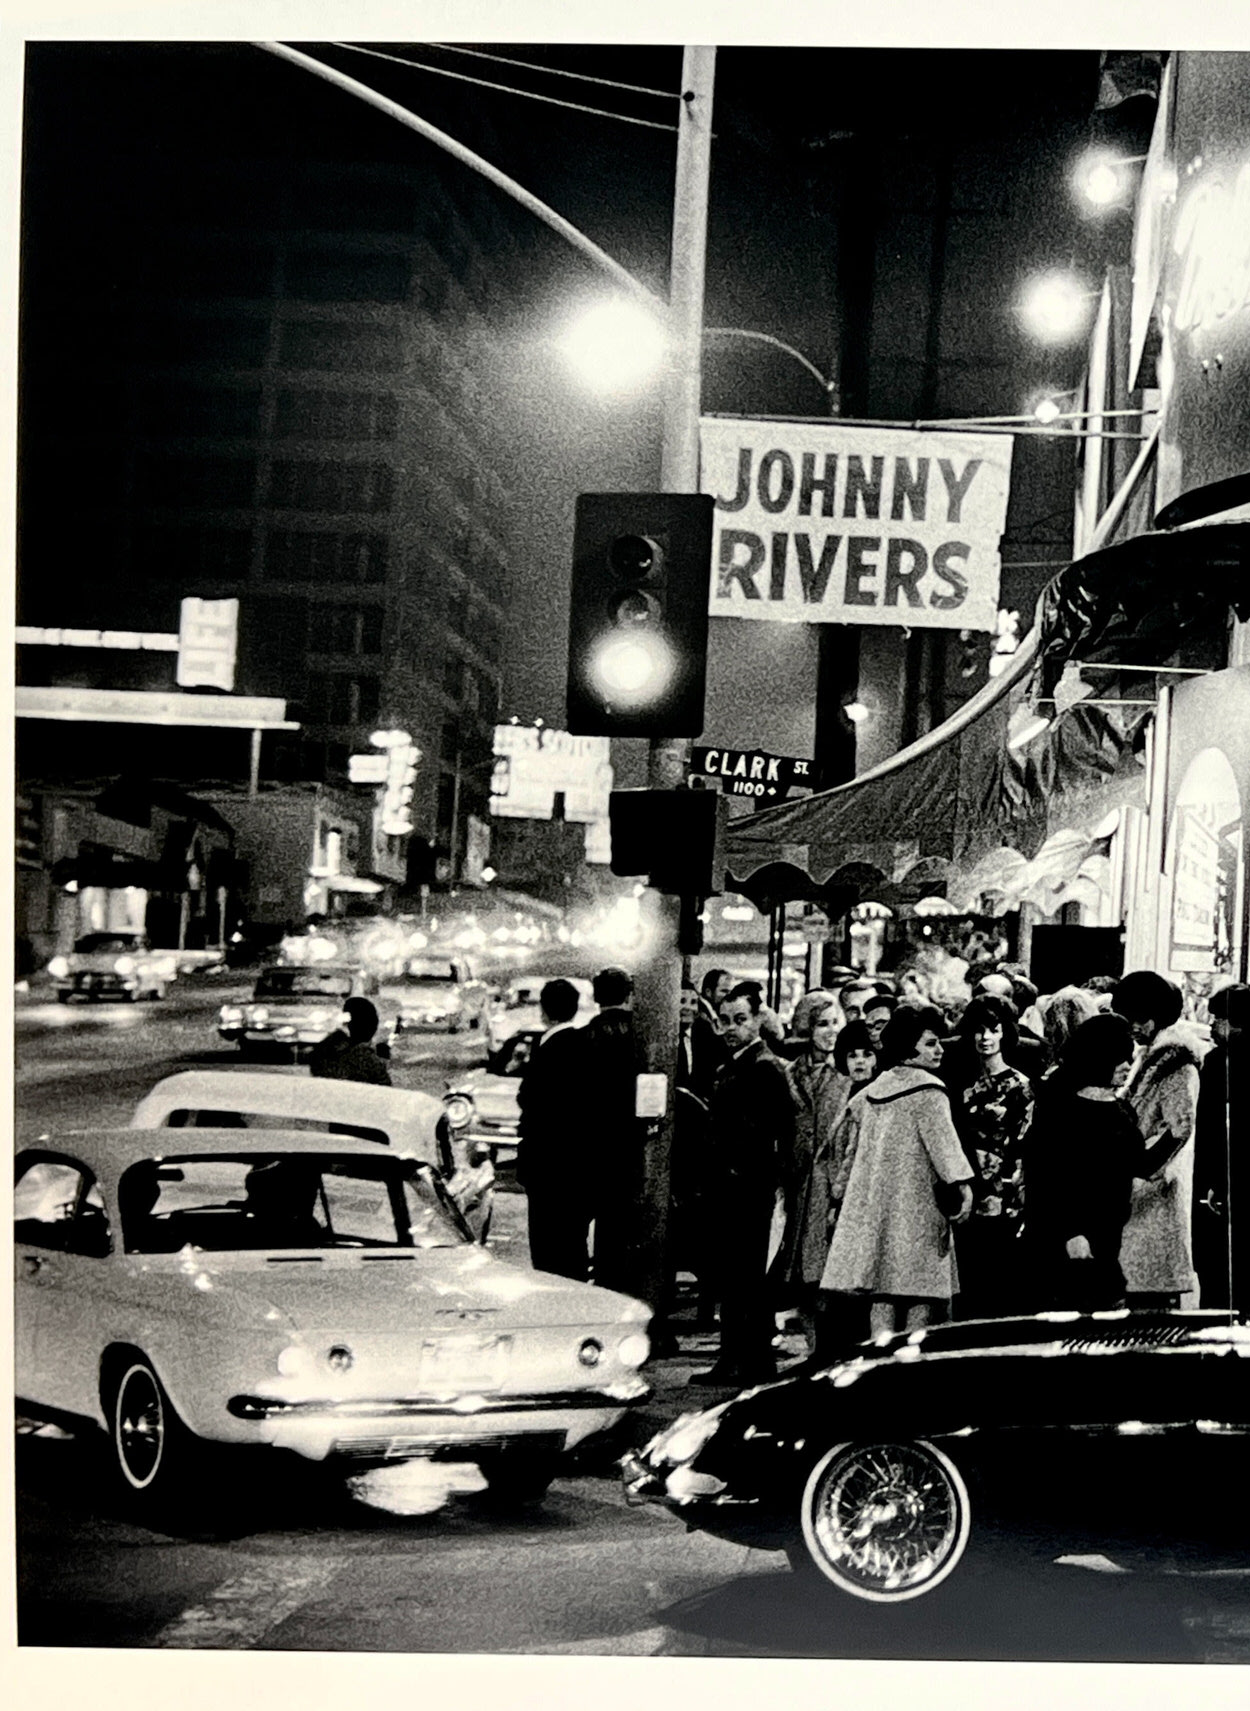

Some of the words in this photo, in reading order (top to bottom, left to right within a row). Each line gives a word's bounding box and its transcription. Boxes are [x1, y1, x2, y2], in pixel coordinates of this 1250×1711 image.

[714, 448, 984, 523] JOHNNY
[716, 529, 972, 610] RIVERS
[704, 750, 782, 781] CLARK
